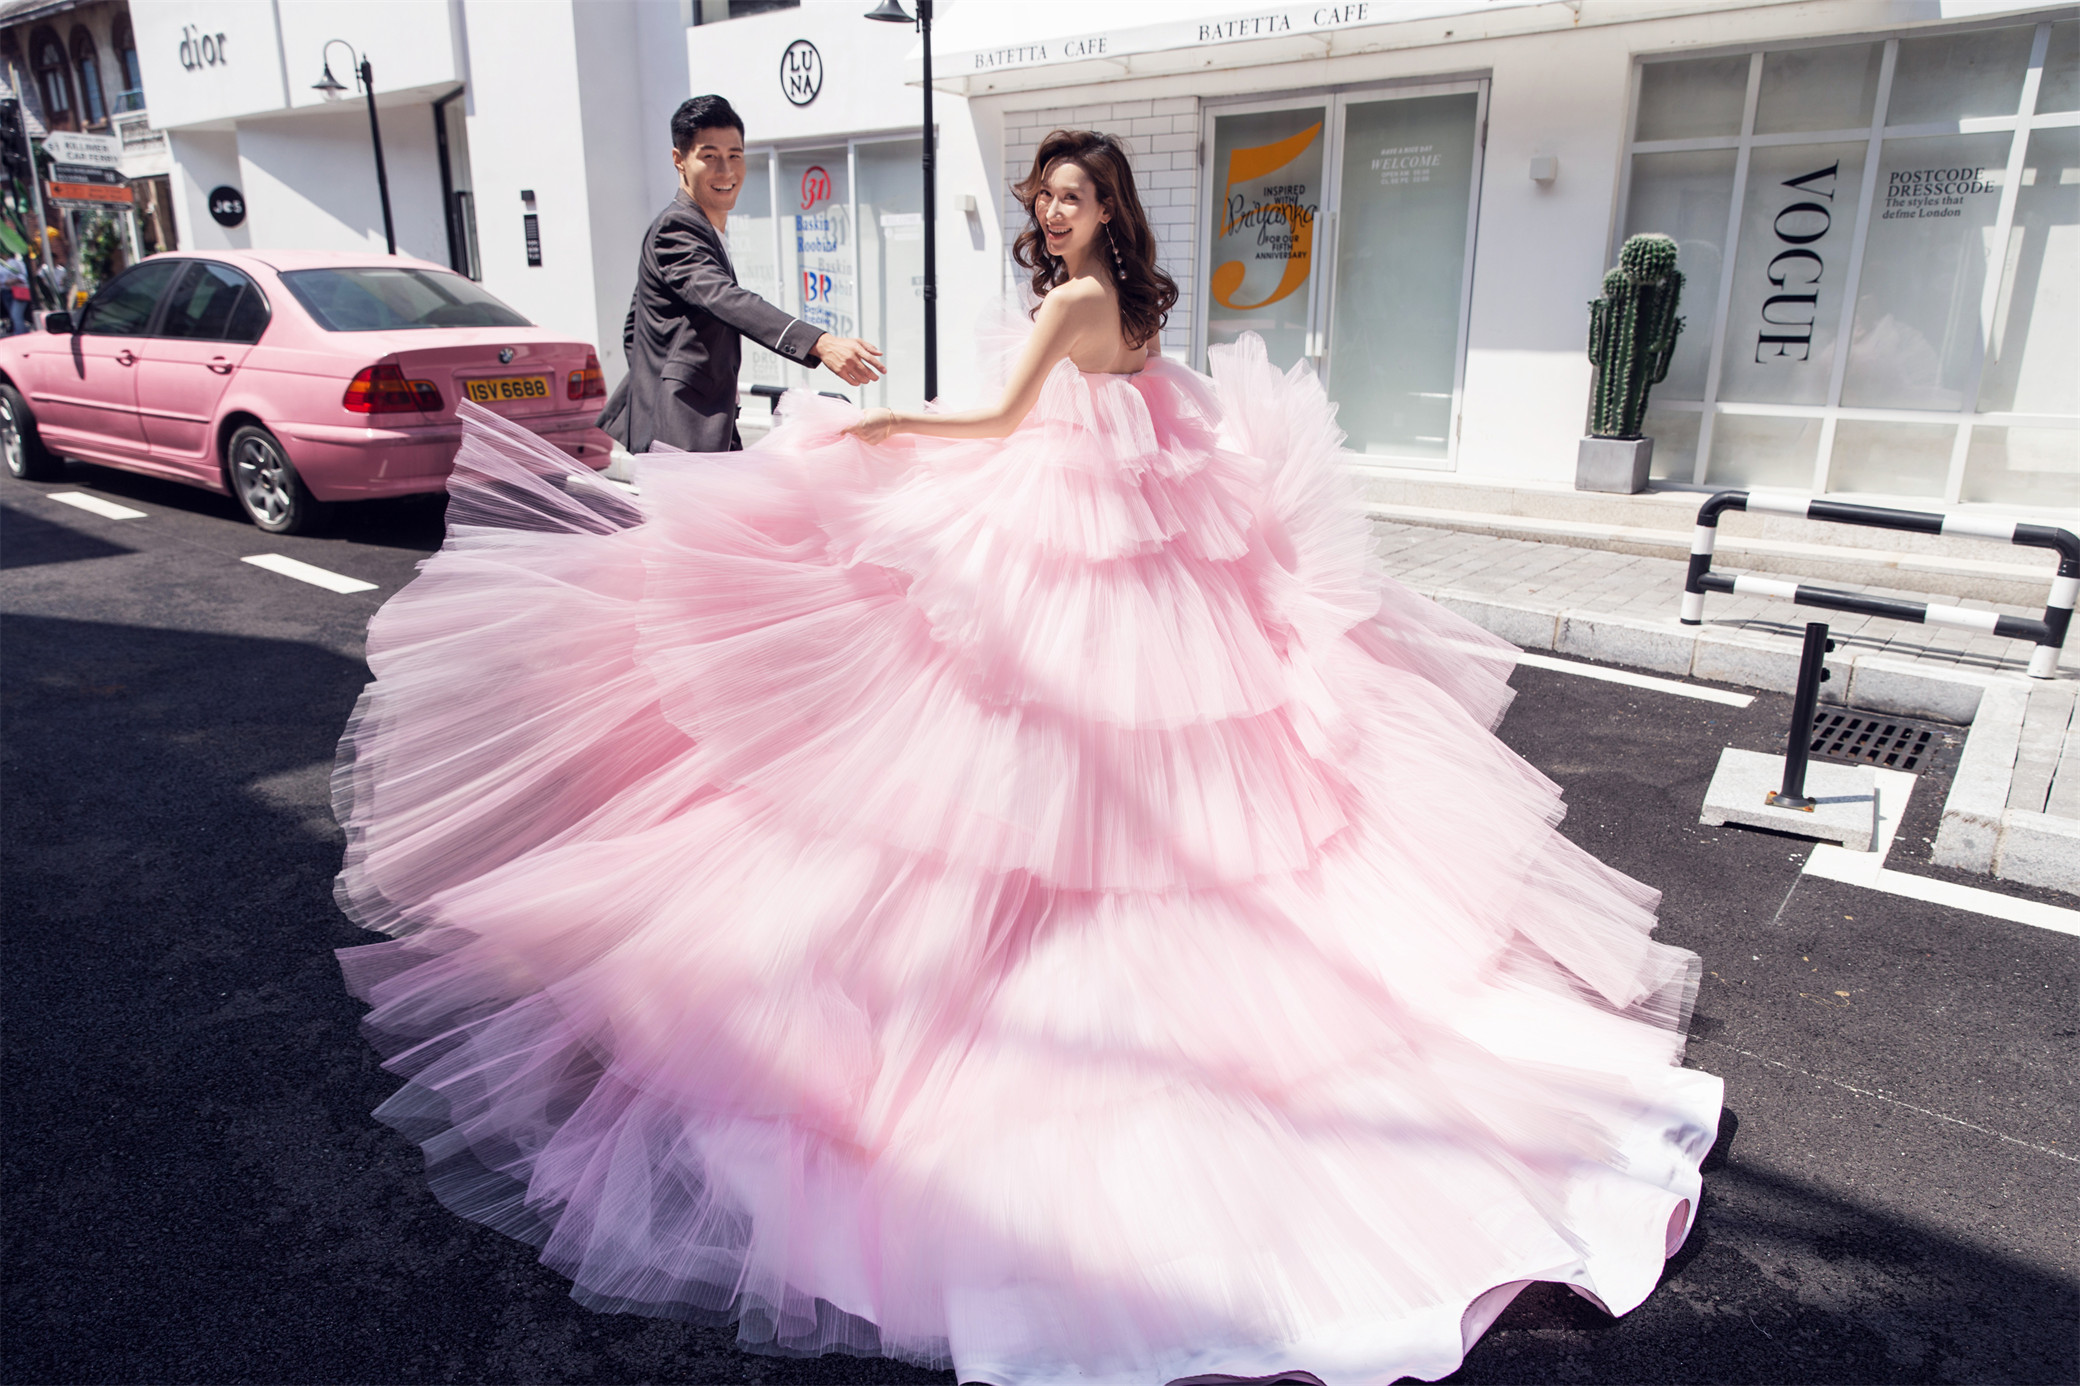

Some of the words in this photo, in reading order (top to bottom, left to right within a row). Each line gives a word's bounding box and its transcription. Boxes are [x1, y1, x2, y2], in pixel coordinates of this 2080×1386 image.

[1199, 14, 1291, 41] BATETTA
[1313, 3, 1368, 26] CAFE
[179, 24, 227, 71] dior
[975, 45, 1047, 69] BATETTA
[1064, 38, 1107, 57] CAFE
[1371, 154, 1442, 171] WELCOME
[1889, 167, 1985, 184] POSTCODE
[801, 176, 826, 210] 31
[1263, 185, 1306, 197] INSPIRED
[1887, 181, 1995, 198] DRESSCODE
[1886, 198, 1906, 208] The
[1908, 197, 1940, 209] styles
[1942, 196, 1964, 206] that
[1211, 121, 1322, 310] 5
[1919, 208, 1962, 218] London
[796, 215, 829, 231] Baskin
[1255, 251, 1307, 260] ANNIVERSARY
[1272, 243, 1293, 251] FIFTH
[1755, 159, 1839, 364] VOGUE
[803, 271, 832, 303] BR
[501, 380, 546, 398] 6688
